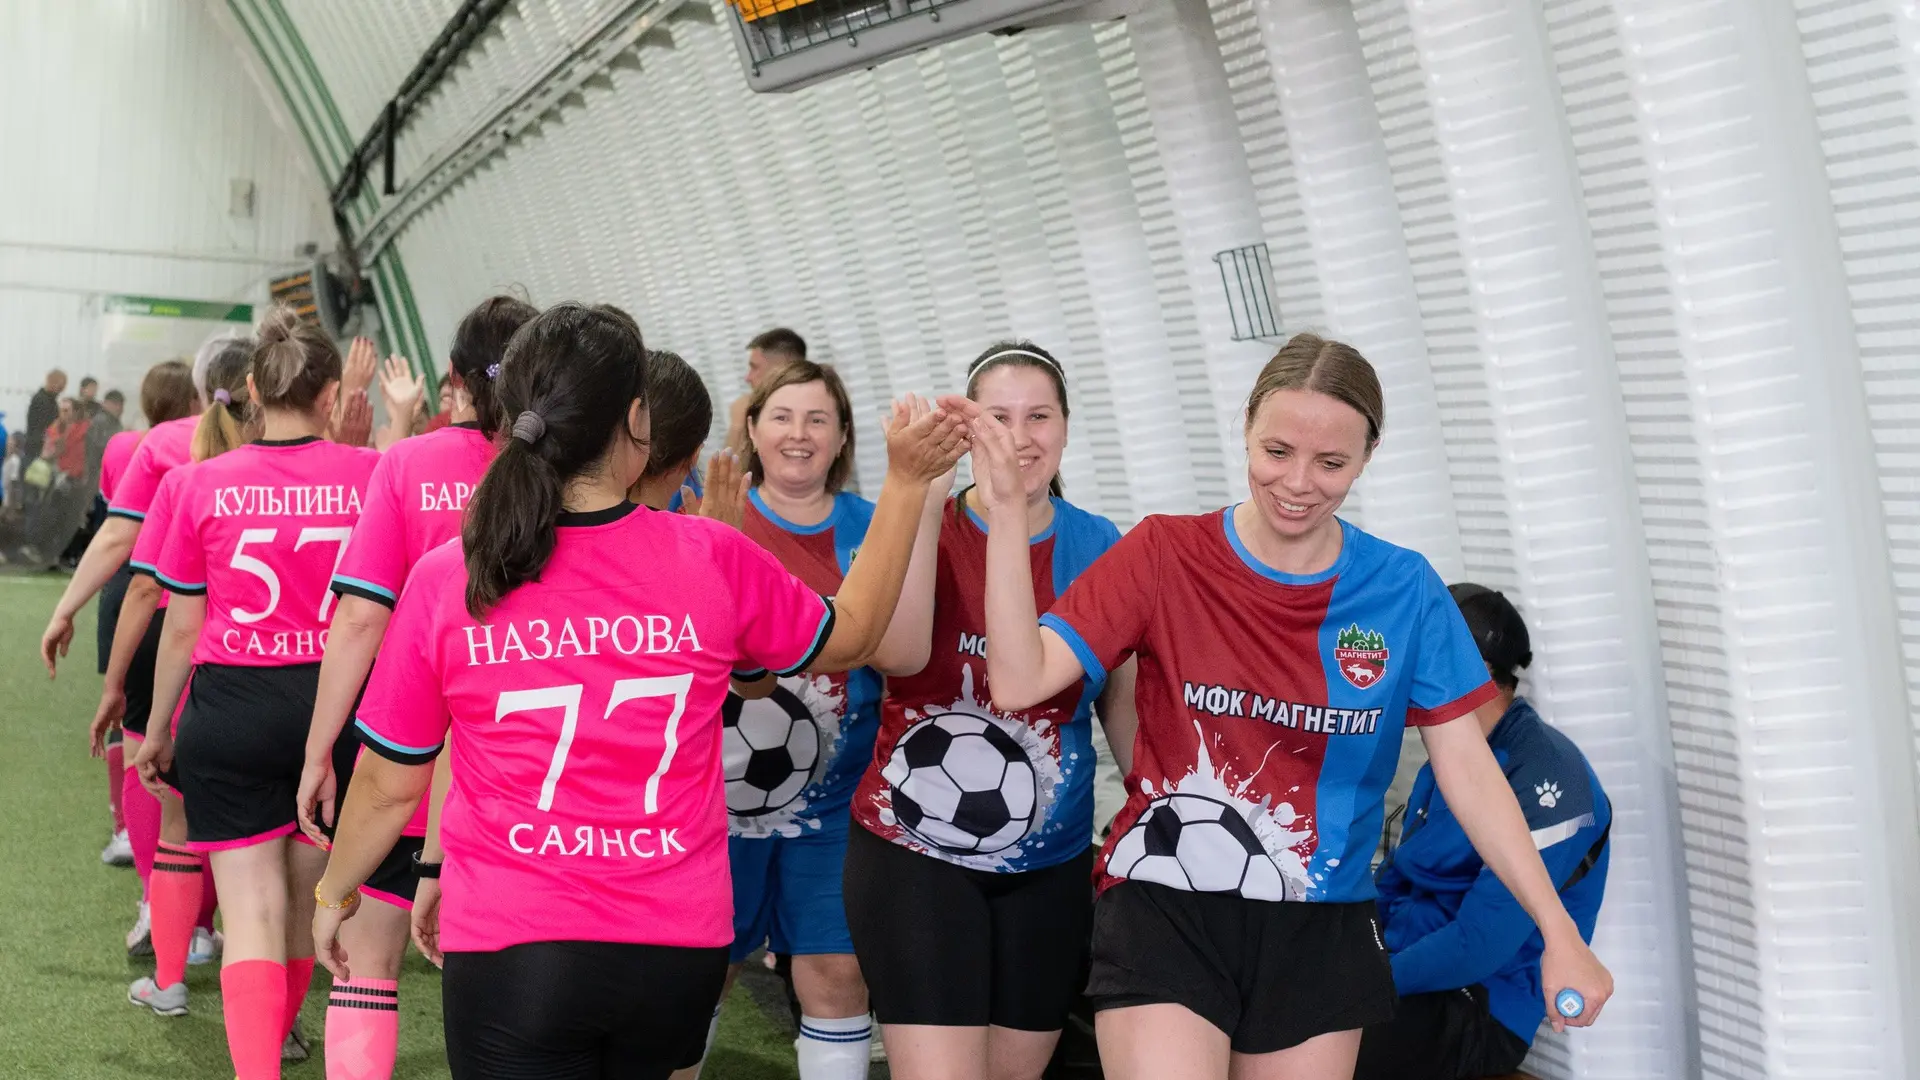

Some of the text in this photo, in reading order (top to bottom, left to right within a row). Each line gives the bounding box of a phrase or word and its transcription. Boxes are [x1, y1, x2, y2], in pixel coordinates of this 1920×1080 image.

[213, 485, 363, 517] КУЛЬПИНА
[229, 526, 354, 623] 57
[463, 613, 703, 666] НАЗАРОВА
[1340, 651, 1383, 659] МАГНЕТИТ
[1183, 681, 1383, 734] МФК МАГНЕТИТ
[494, 672, 694, 815] 77
[508, 823, 687, 858] САЯНСК
